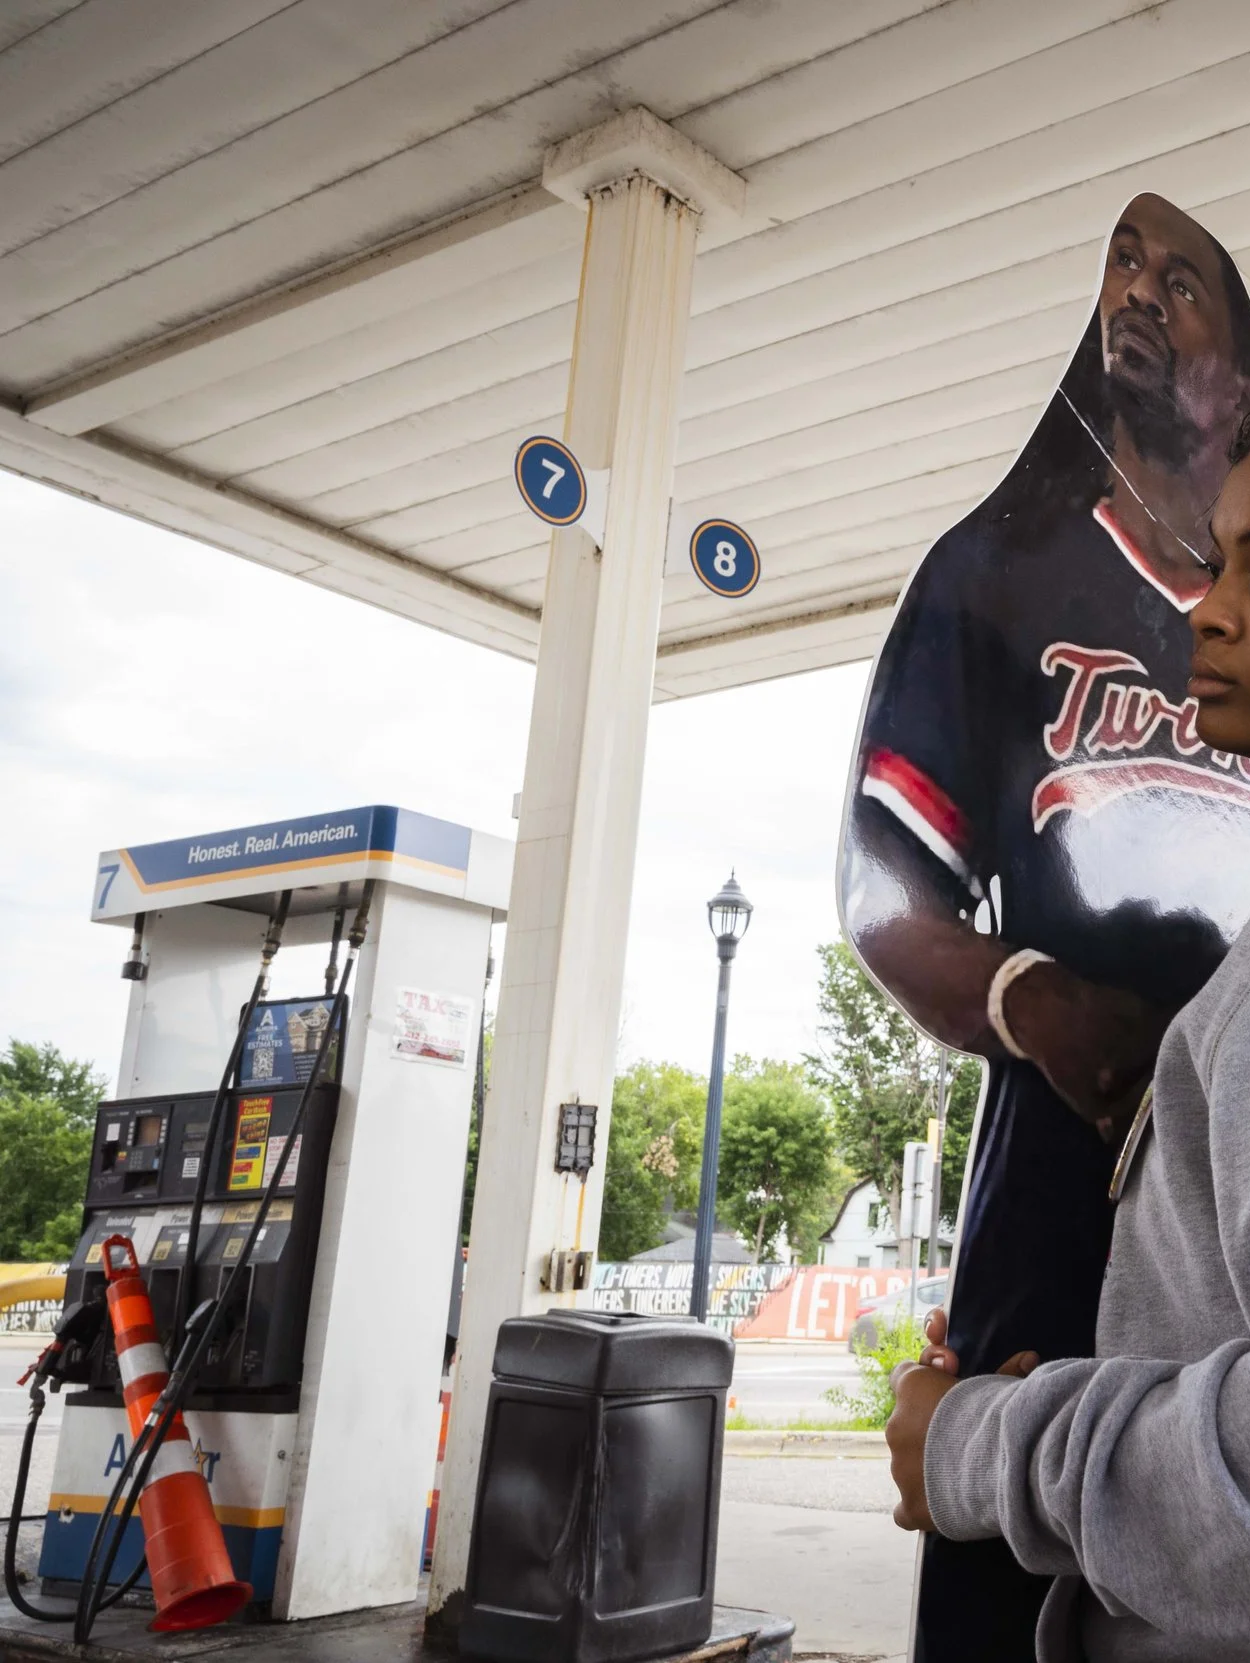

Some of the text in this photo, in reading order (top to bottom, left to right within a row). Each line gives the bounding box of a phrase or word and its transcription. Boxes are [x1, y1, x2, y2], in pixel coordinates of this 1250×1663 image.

[541, 457, 566, 499] 7
[712, 540, 737, 578] 8
[187, 823, 358, 864] Honest. Real. American.
[98, 863, 121, 910] 7
[404, 991, 447, 1015] TAX
[247, 1039, 283, 1050] ESTIMATES
